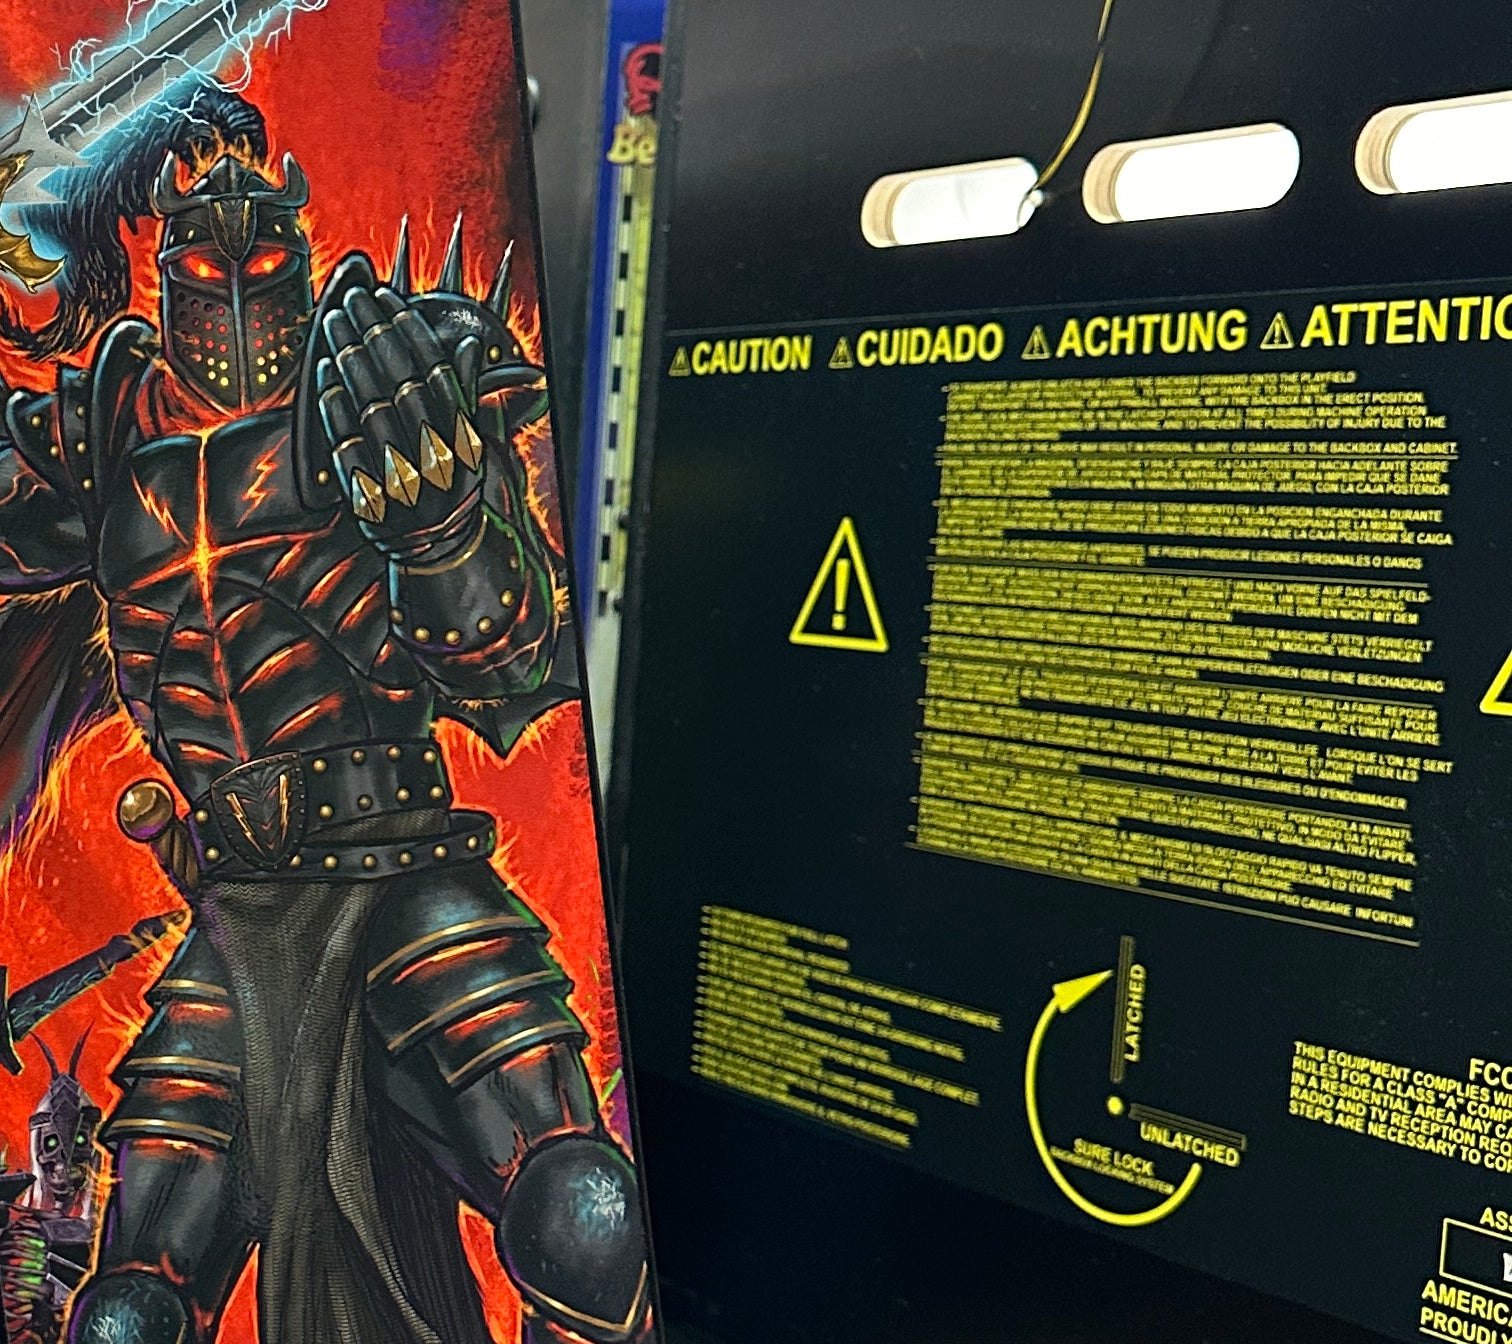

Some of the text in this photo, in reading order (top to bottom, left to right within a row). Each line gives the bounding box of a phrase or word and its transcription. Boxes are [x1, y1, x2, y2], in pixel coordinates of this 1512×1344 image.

[691, 334, 813, 375] CAUTION
[856, 322, 1005, 367] CUIDADO
[1056, 309, 1248, 358] ACHTUNG
[1124, 964, 1146, 1062] LATCHED
[1293, 1056, 1338, 1078] RULES
[1342, 1069, 1370, 1088] FOR
[1373, 1077, 1384, 1091] A
[1387, 1080, 1435, 1104] CLASS
[1294, 1041, 1325, 1061] THIS
[1328, 1049, 1411, 1082] EQUIPMENT
[1413, 1071, 1490, 1102] COMPLIES
[1289, 1099, 1334, 1124] STEPS
[1335, 1113, 1366, 1134] ARE
[1368, 1121, 1457, 1157] NECESSARY
[1460, 1145, 1482, 1165] TO
[1290, 1085, 1335, 1107] RADIO
[1336, 1099, 1367, 1116] AND
[1370, 1106, 1389, 1122] TV
[1391, 1111, 1476, 1146] RECEPTION
[1292, 1071, 1307, 1085] IN
[1308, 1075, 1319, 1088] A
[1321, 1079, 1412, 1114] RESIDENTIAL
[1415, 1103, 1456, 1126] AREA
[1459, 1114, 1492, 1134] MAY
[1074, 1138, 1112, 1163] SURE
[1114, 1151, 1155, 1176] LOCK
[1140, 1121, 1240, 1167] UNLATCHED
[1480, 1207, 1512, 1232] AS
[1421, 1280, 1512, 1327] AMERIC
